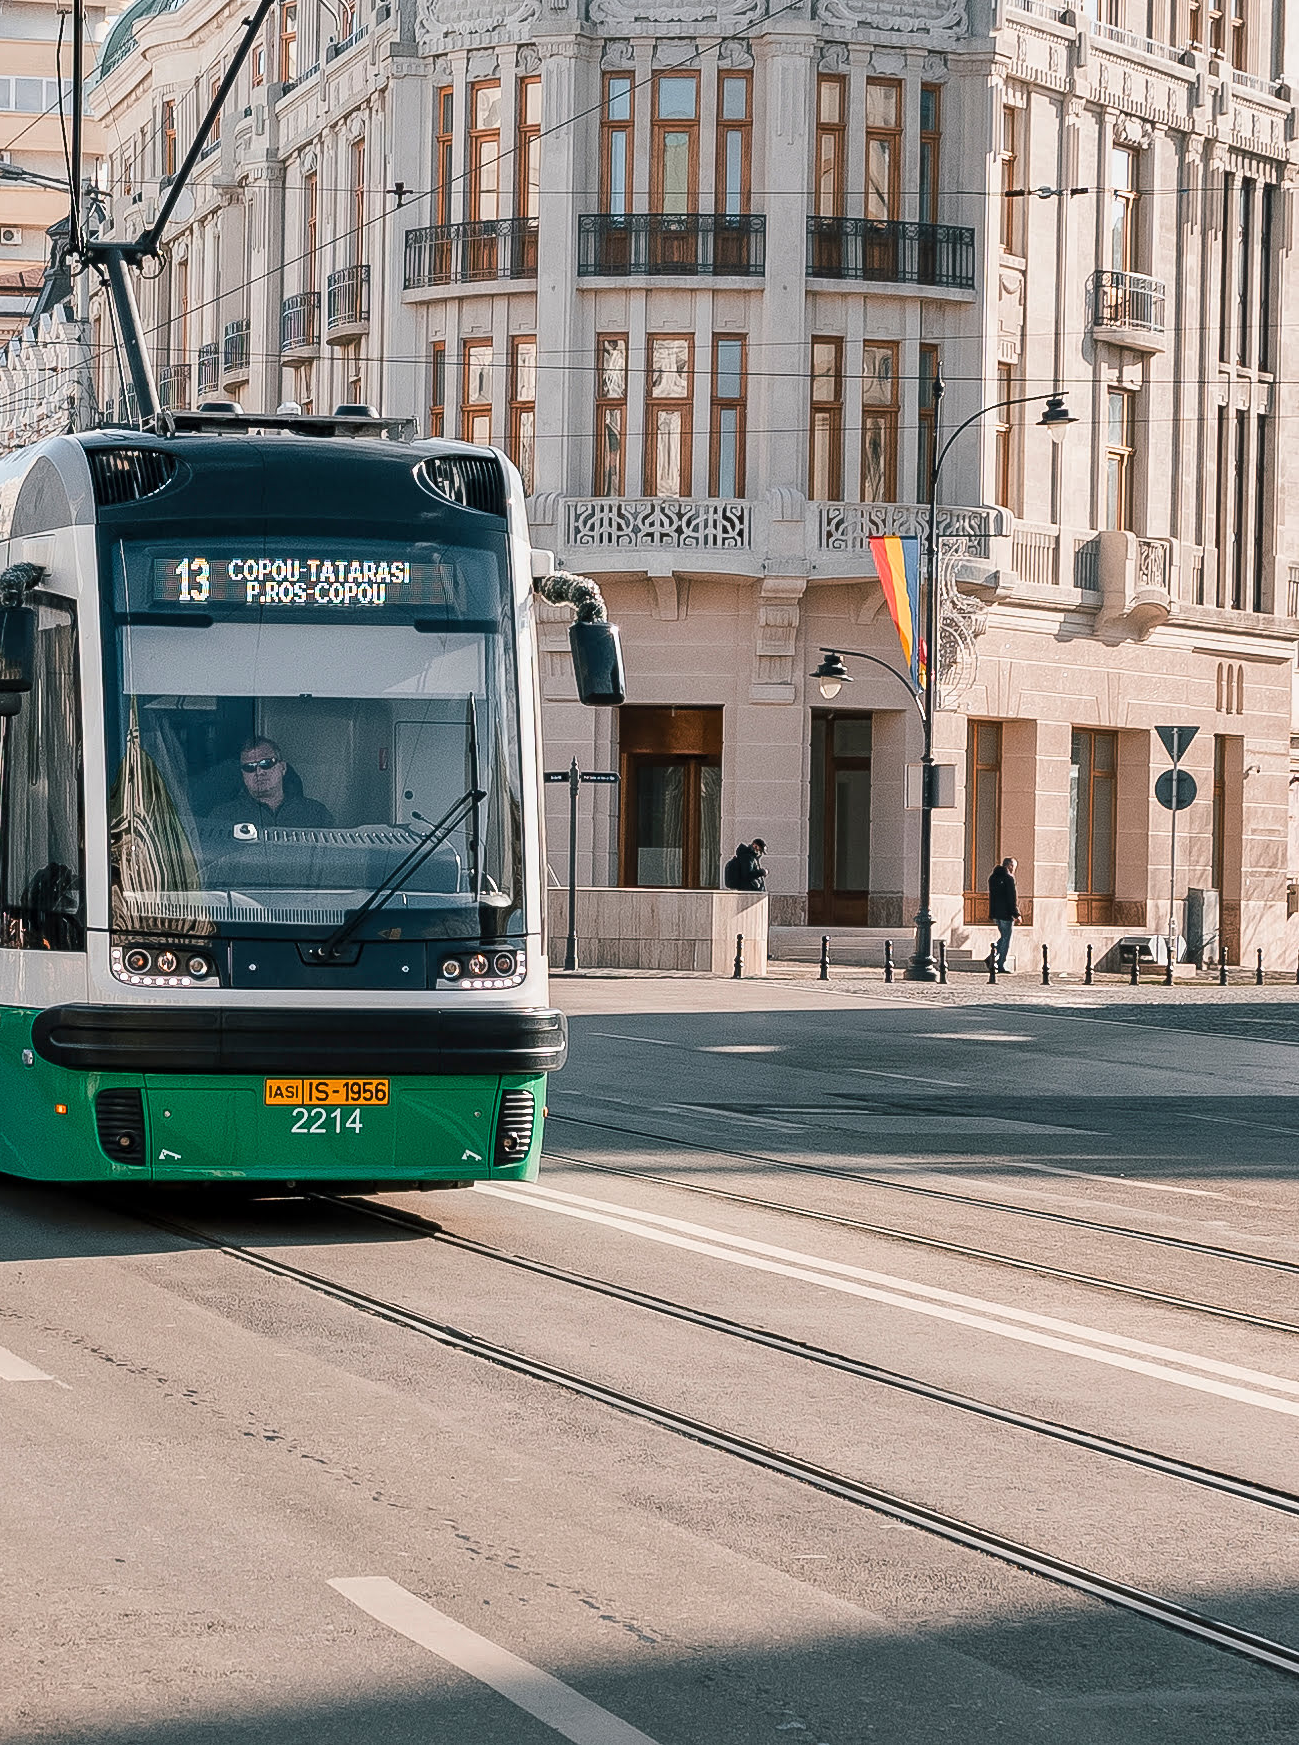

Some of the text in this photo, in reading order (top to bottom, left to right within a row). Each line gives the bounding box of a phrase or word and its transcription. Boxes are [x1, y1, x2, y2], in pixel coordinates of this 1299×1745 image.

[175, 557, 411, 601] 13 COPOU-TATARASI
[246, 582, 386, 604] P.ROS-COPOU
[269, 1082, 387, 1102] IASI IS-1956
[291, 1107, 363, 1134] 2214
